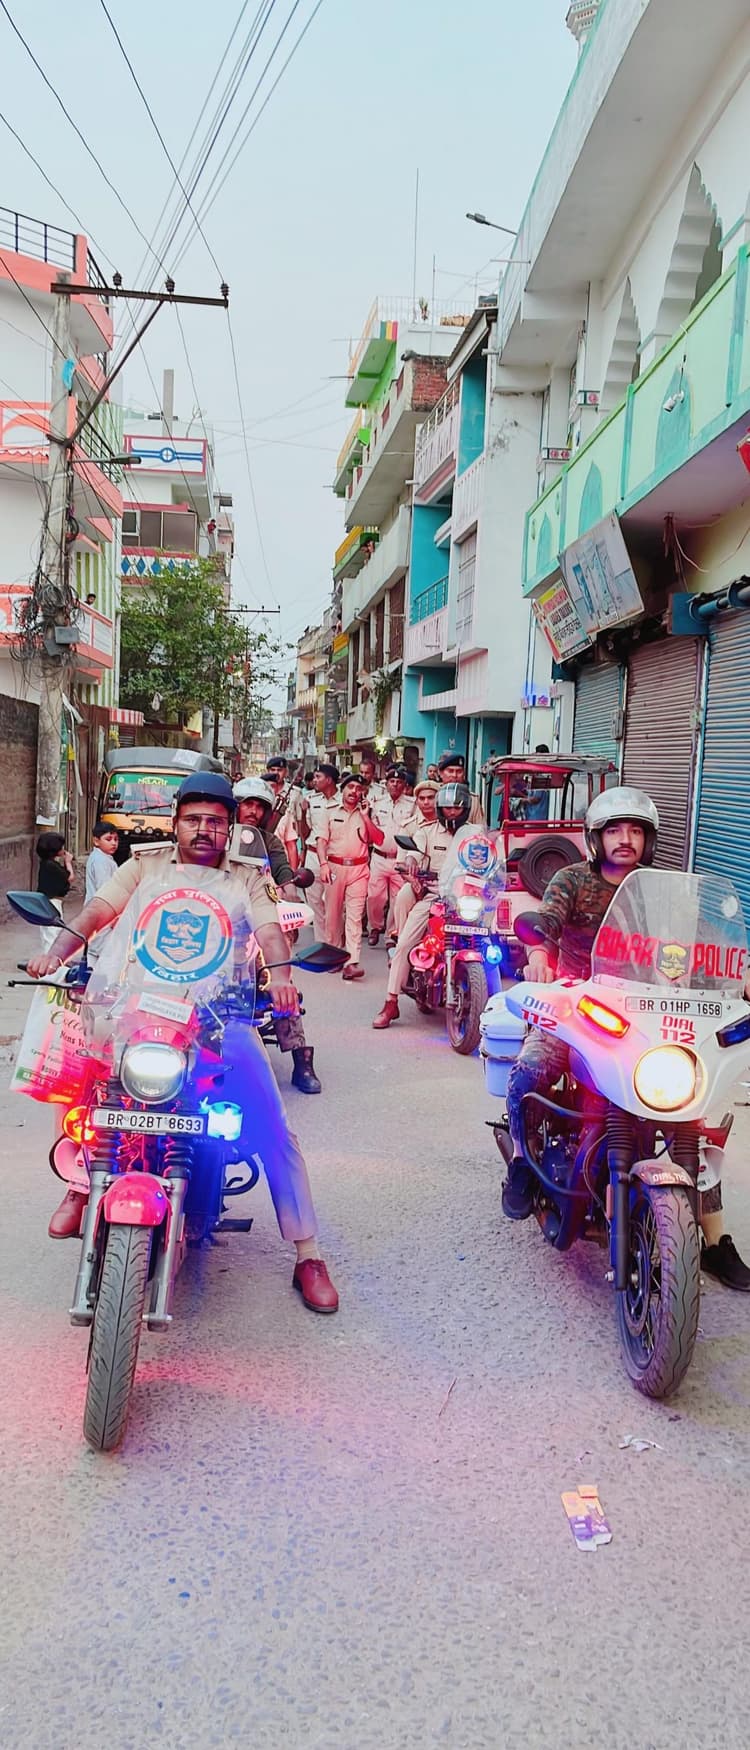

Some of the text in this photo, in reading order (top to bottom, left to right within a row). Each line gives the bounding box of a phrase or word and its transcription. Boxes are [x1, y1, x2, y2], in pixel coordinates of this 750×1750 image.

[183, 889, 220, 910] पुलिस
[283, 911, 304, 920] DIAL
[283, 920, 304, 930] 112
[596, 925, 747, 980] BIHAR POLICE
[522, 995, 559, 1018] DIAL
[639, 999, 721, 1016] BR 01HP 1658
[521, 1008, 558, 1031] 112
[662, 1015, 696, 1033] DIAL
[659, 1028, 696, 1045] 112
[107, 1113, 201, 1132] BR 02BT 8693
